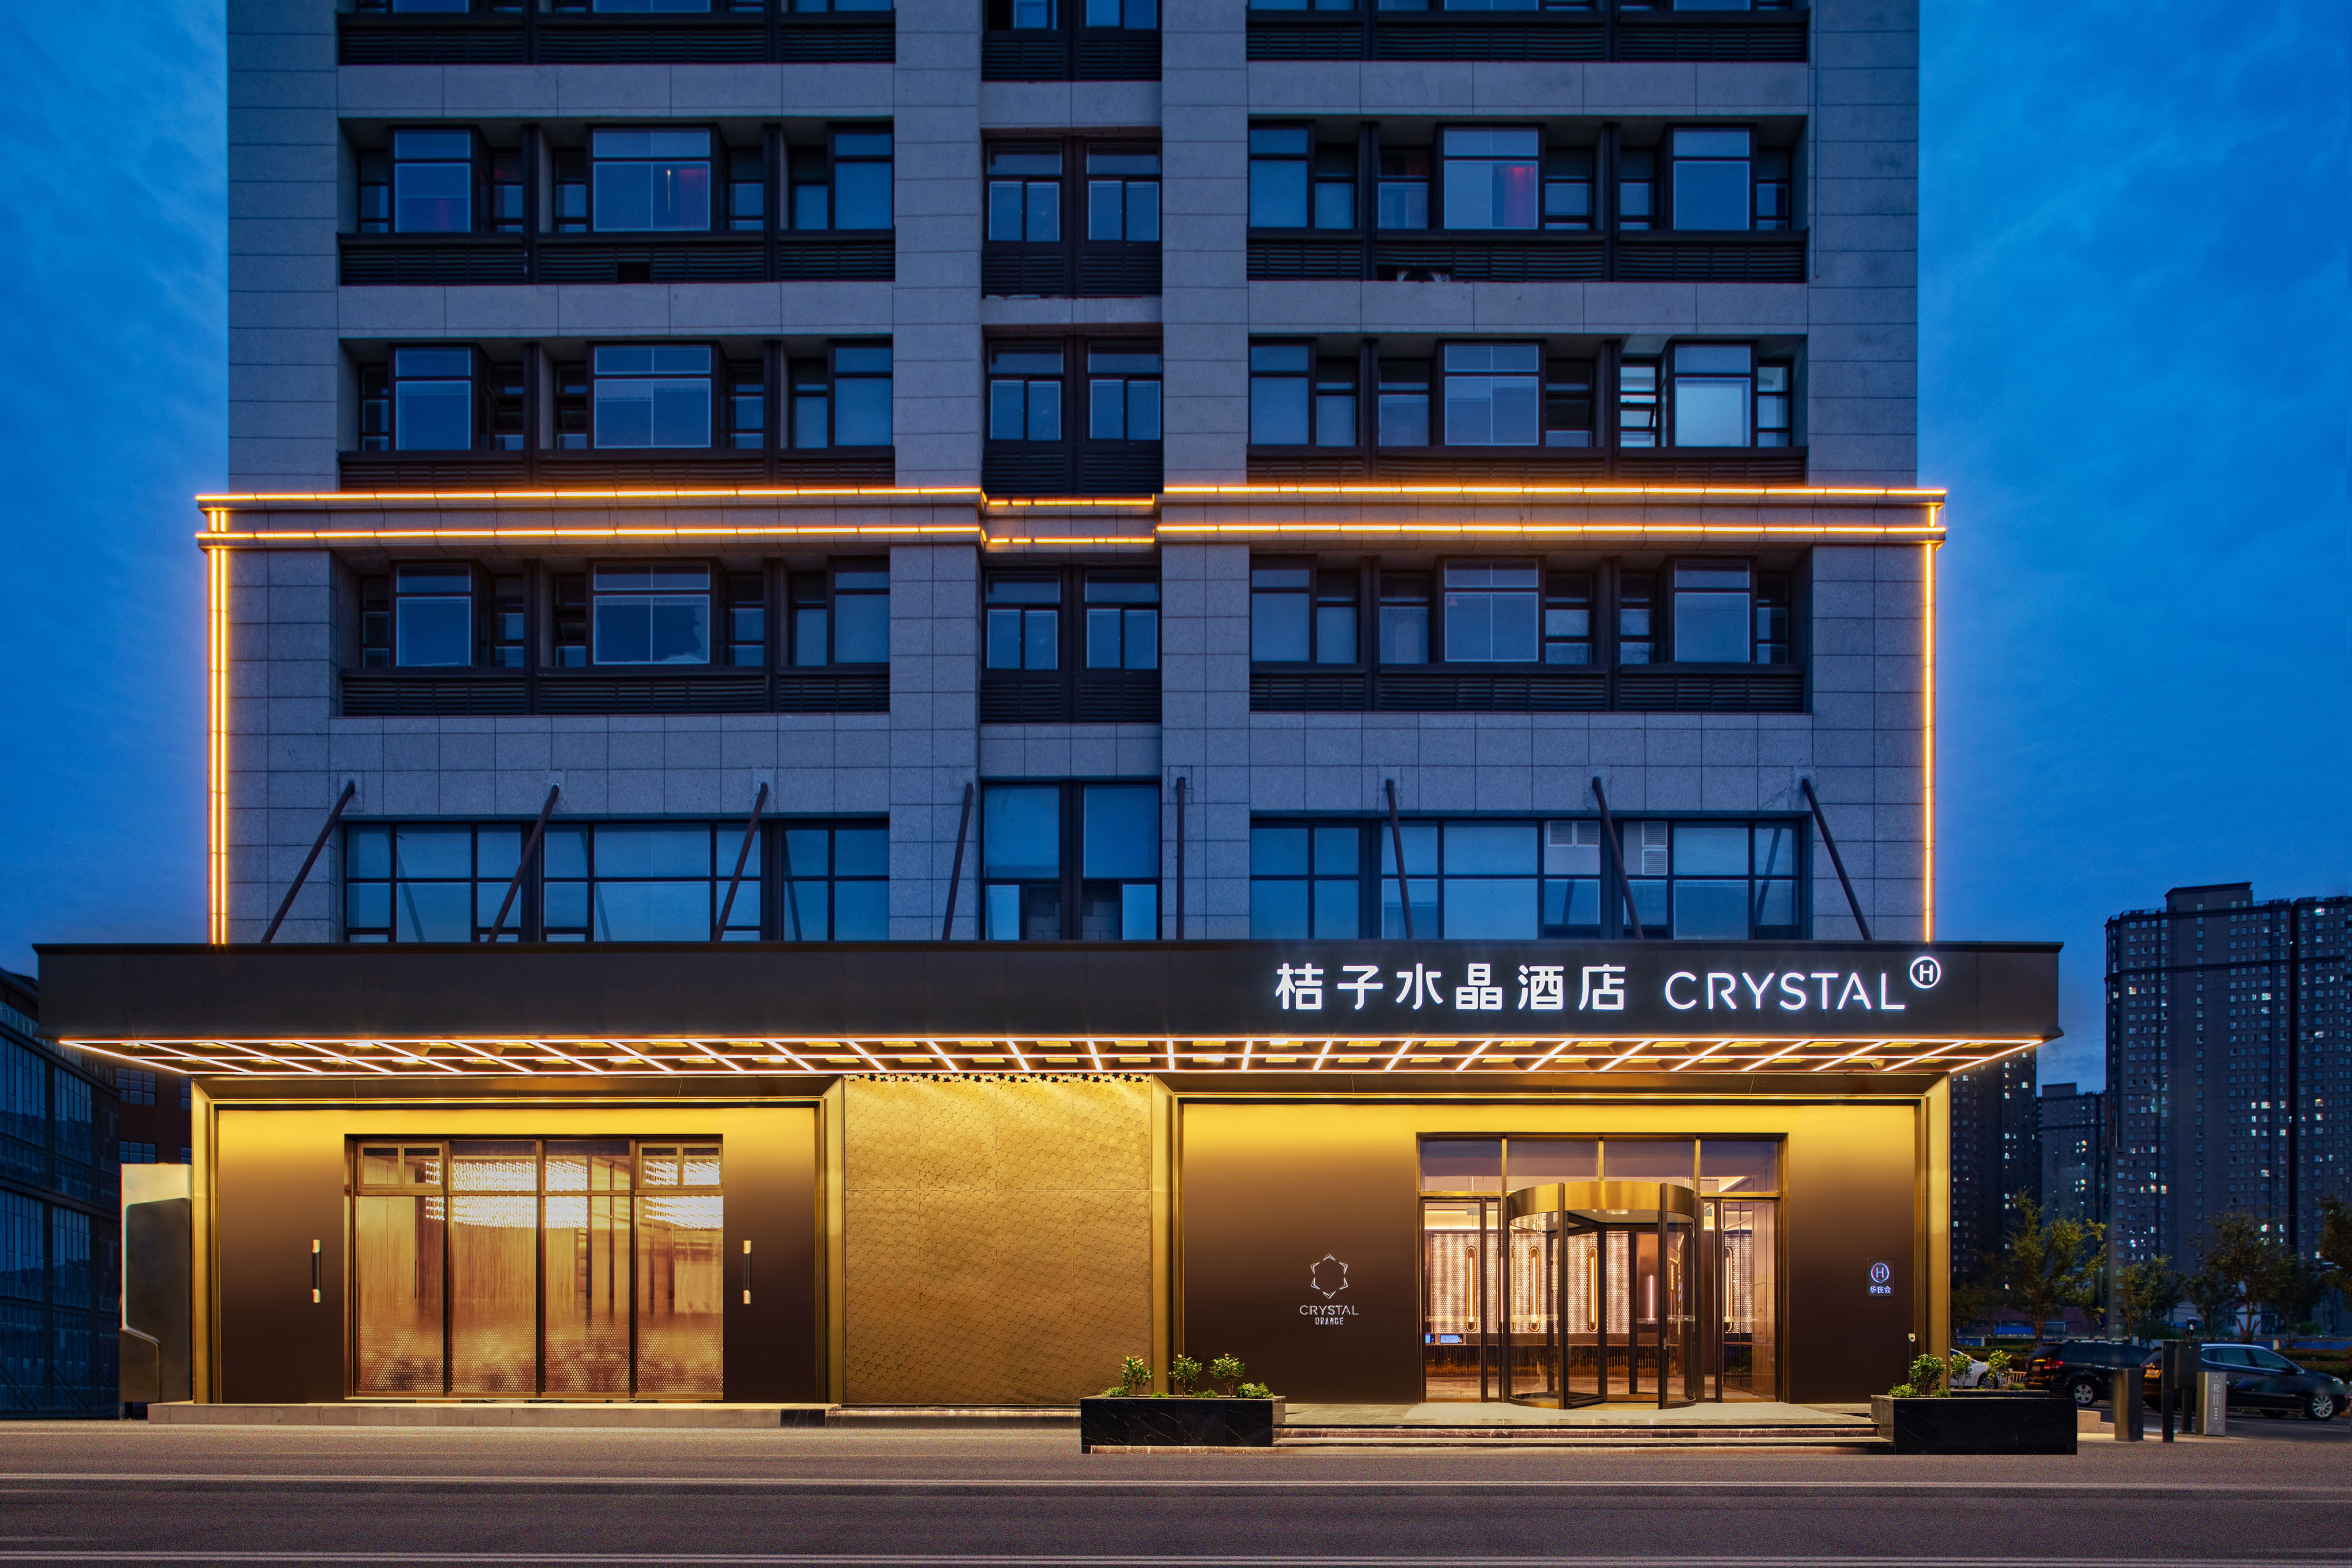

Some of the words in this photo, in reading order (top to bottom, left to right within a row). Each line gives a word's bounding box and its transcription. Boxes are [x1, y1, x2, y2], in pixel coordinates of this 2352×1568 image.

[1275, 962, 1626, 1011] 桔子水晶酒店
[1665, 971, 1906, 1010] CRYSTAL
[1869, 1285, 1891, 1293] 华住会
[1299, 1305, 1359, 1316] CRYSTAL
[1314, 1316, 1344, 1326] ORANGE
